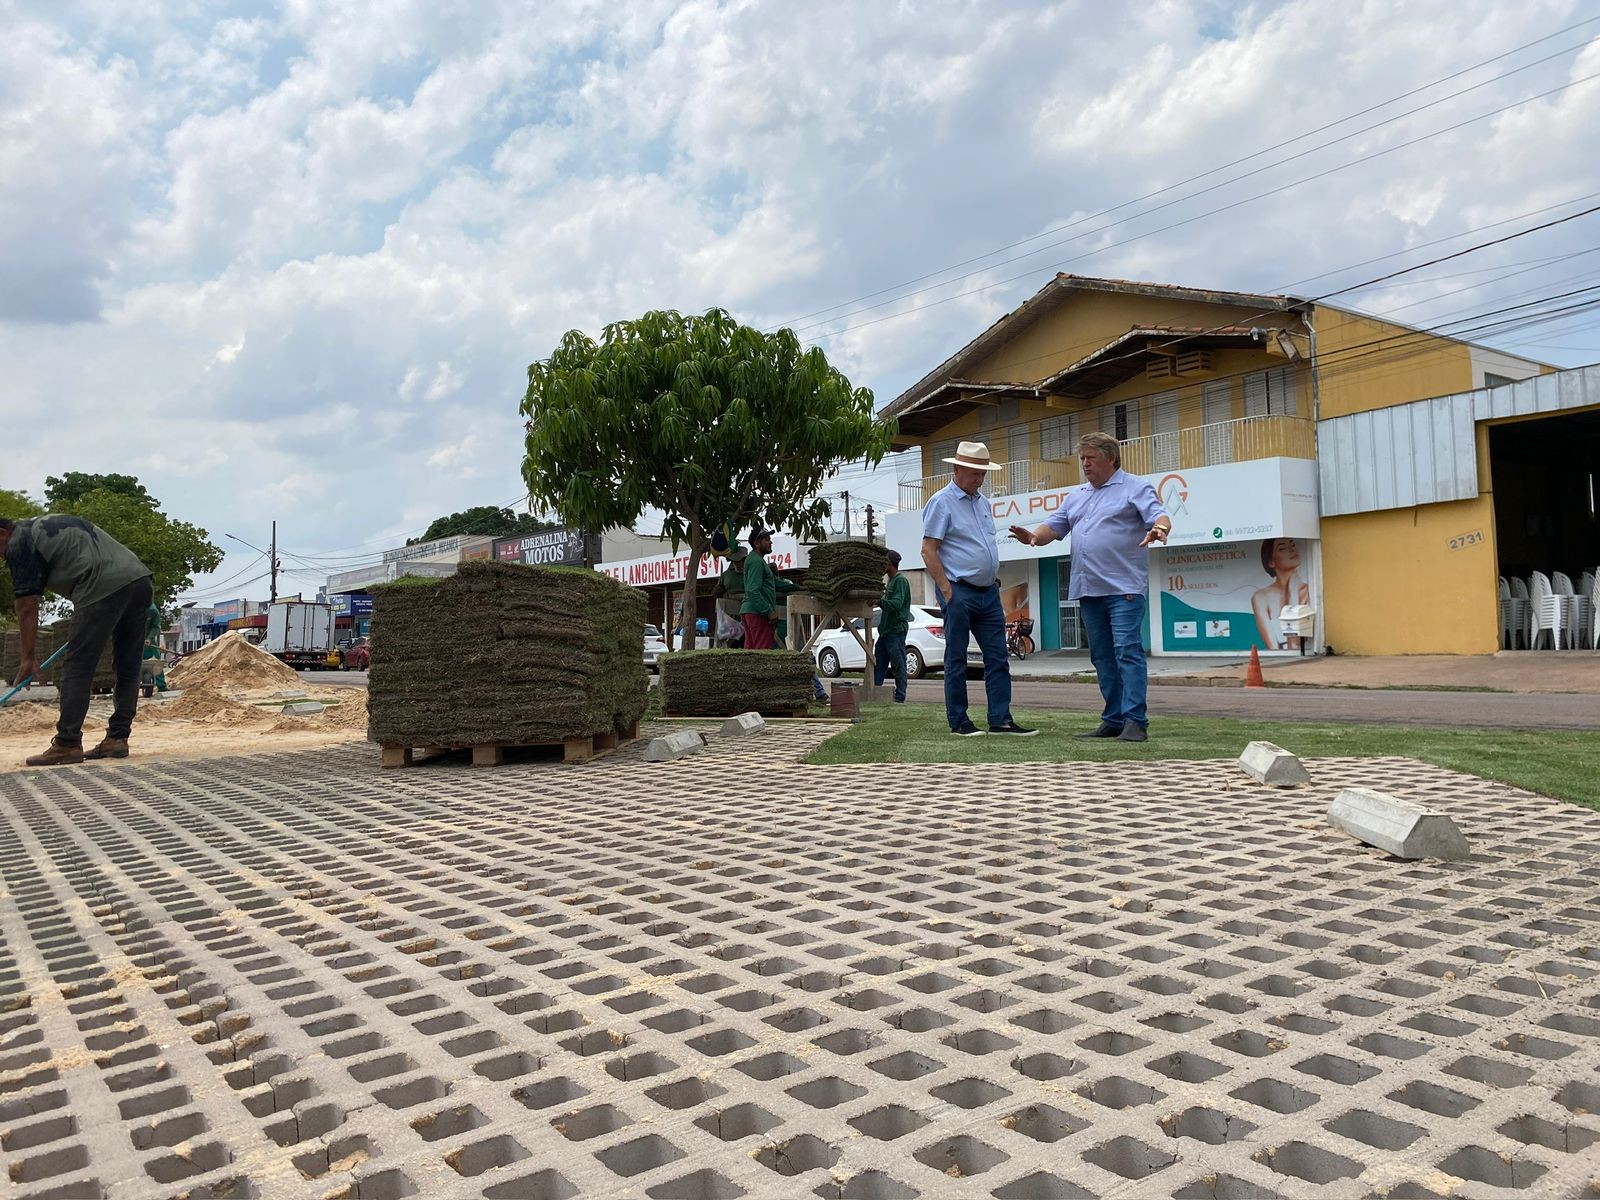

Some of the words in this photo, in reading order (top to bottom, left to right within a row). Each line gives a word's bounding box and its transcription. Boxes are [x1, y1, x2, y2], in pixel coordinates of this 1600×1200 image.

[992, 500, 1021, 518] CA
[520, 531, 568, 550] ADRENALINA
[1197, 544, 1224, 552] conceito
[1449, 531, 1483, 549] 2731
[525, 544, 564, 564] MOTOS
[622, 556, 690, 584] LANCHONETE
